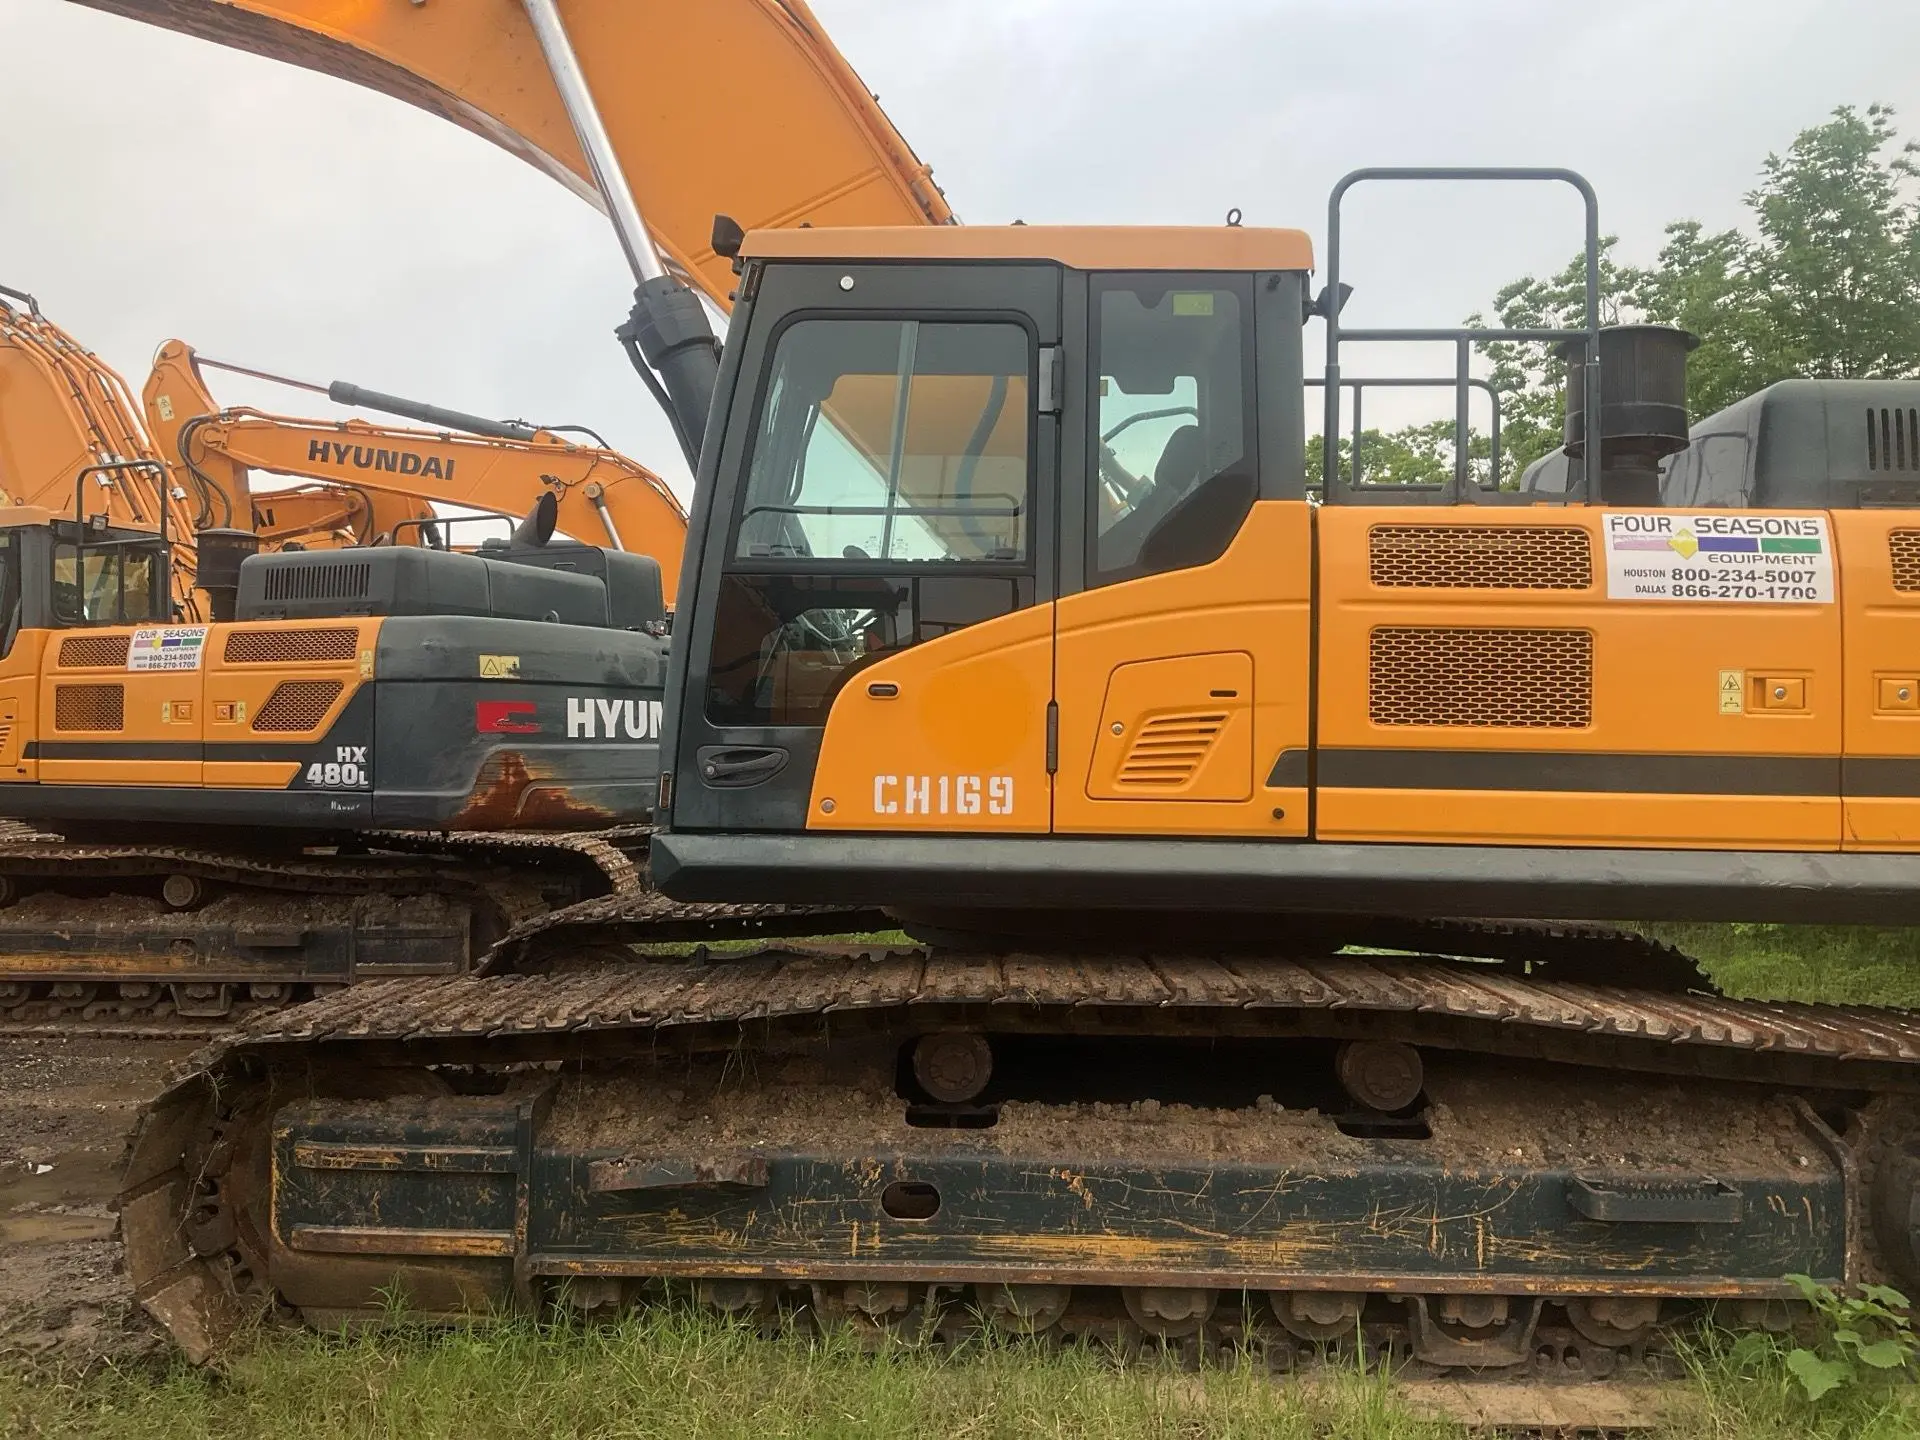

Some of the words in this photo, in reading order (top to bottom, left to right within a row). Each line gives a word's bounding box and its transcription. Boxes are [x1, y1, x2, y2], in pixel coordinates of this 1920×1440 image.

[308, 439, 455, 480] HYUNDAI
[1611, 516, 1672, 533] FOUR
[1694, 517, 1819, 536] SEASONS
[1708, 554, 1816, 565] EQUIPMENT
[1624, 569, 1666, 578] HOUSTON
[1671, 568, 1817, 584] 800-234-5007
[1635, 585, 1666, 594] DALLAS
[1671, 584, 1817, 600] 866-270-1700
[136, 630, 157, 639] FOUR
[164, 629, 205, 638] SEASONS
[336, 746, 367, 763] HX
[306, 763, 369, 787] 480L
[874, 775, 1013, 814] CH169
